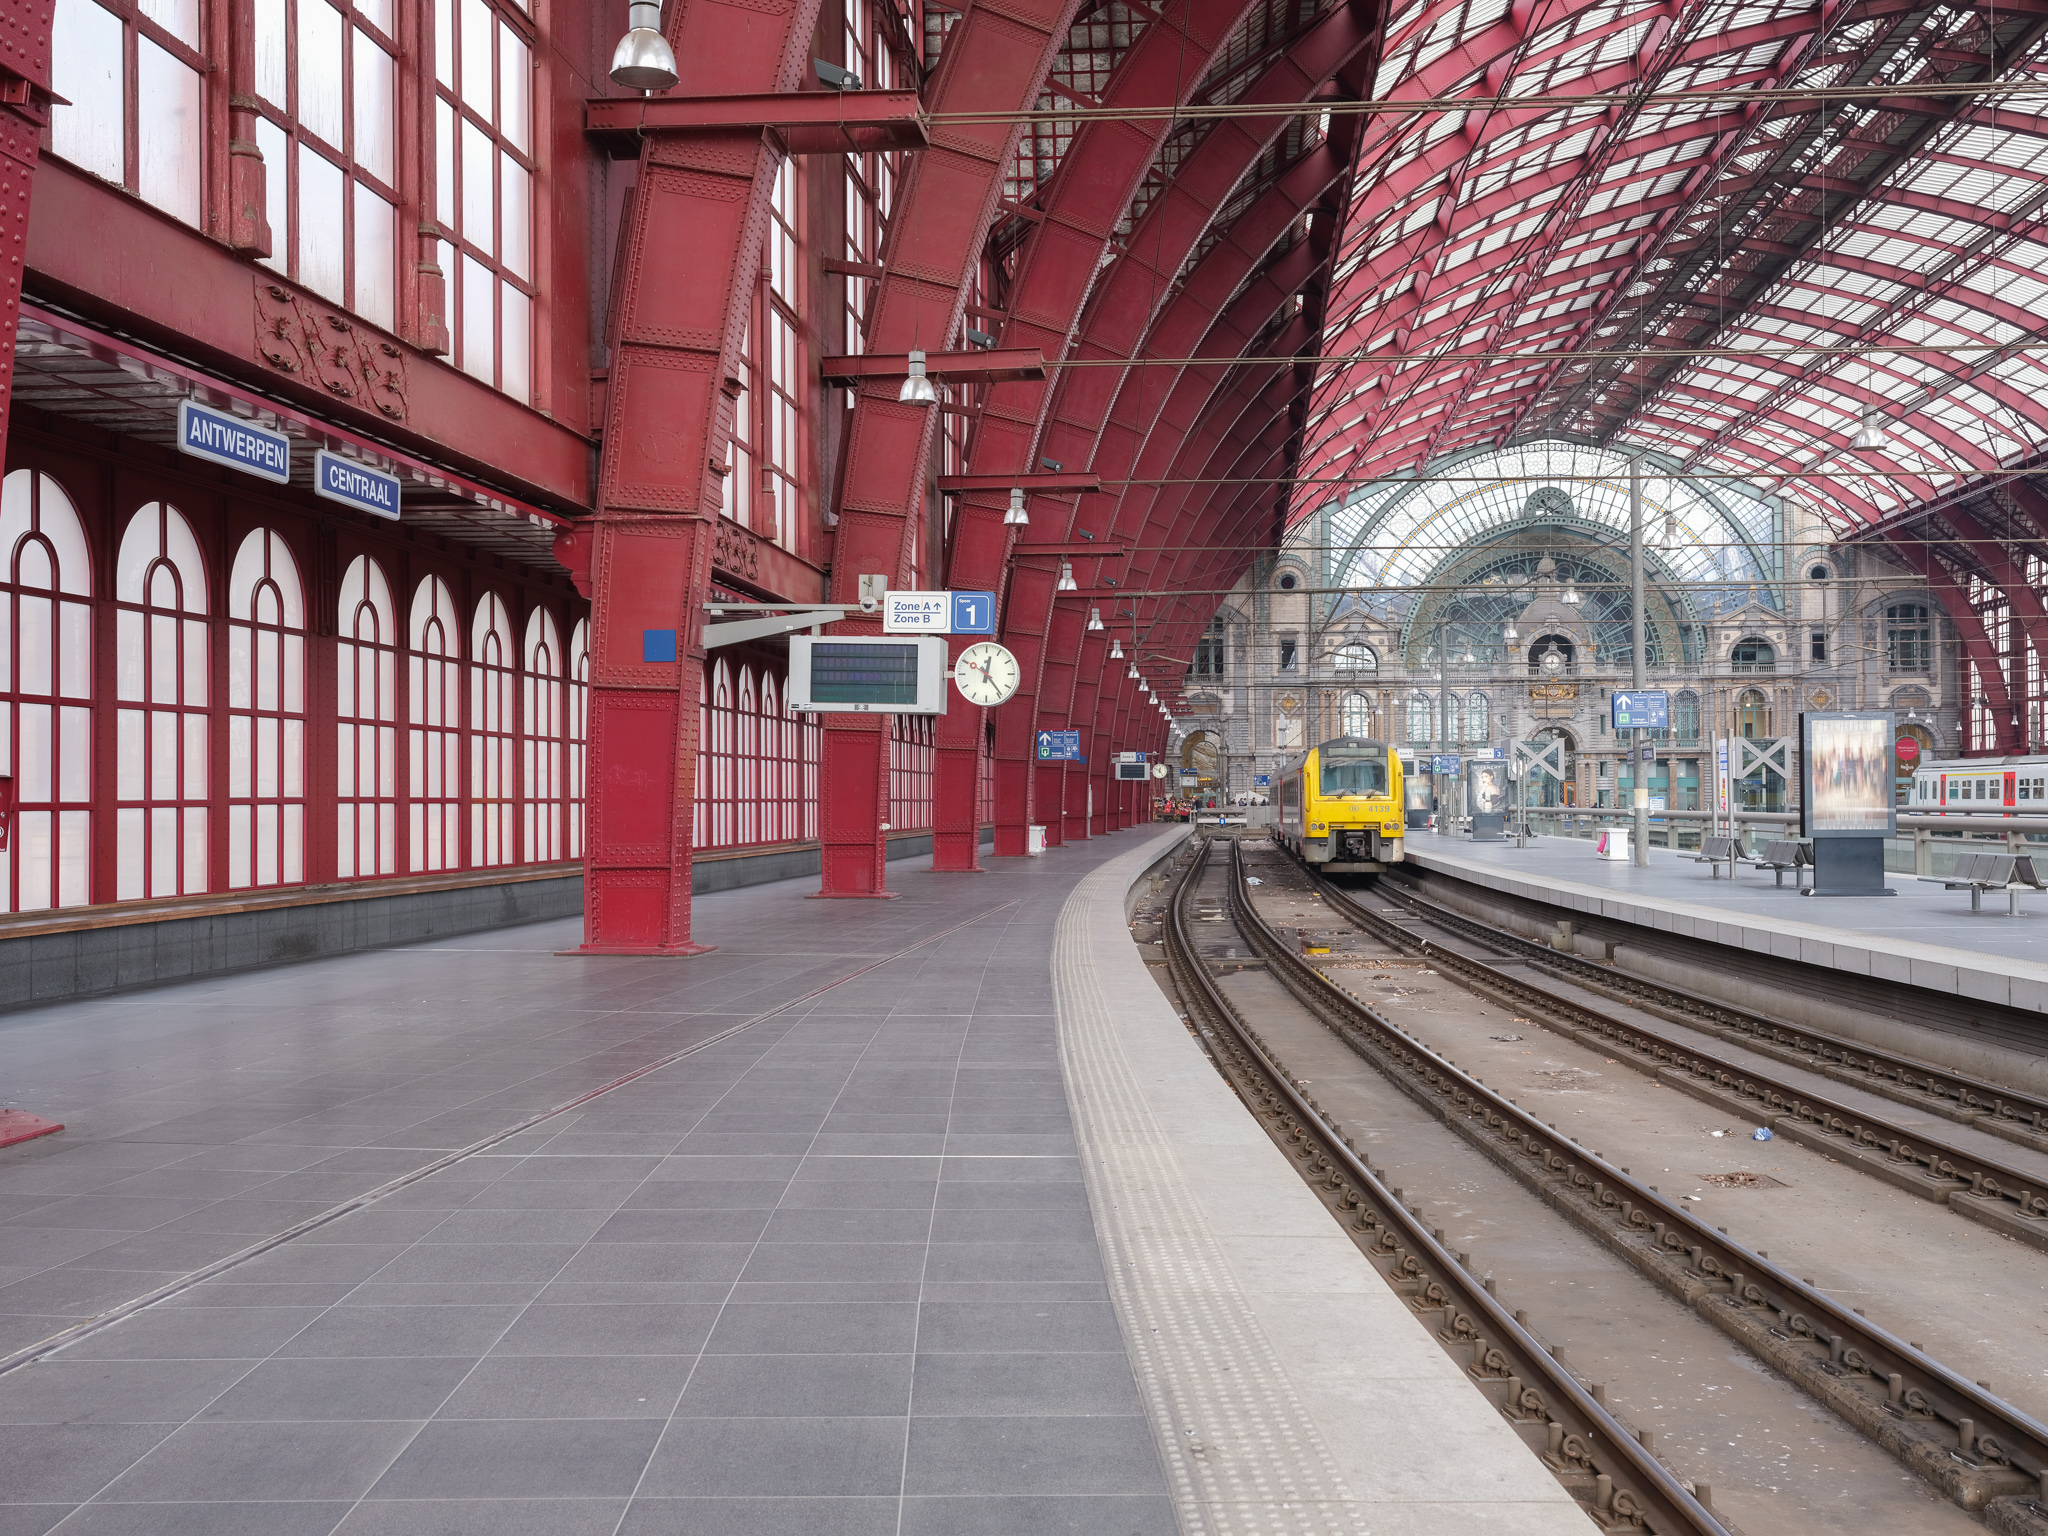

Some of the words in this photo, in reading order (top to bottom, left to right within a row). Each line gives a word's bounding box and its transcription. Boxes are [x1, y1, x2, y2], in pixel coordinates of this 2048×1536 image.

[190, 416, 284, 470] ANTWERPEN
[329, 465, 391, 507] CENTRAAL
[894, 602, 920, 611] Zone
[923, 602, 931, 610] A
[894, 614, 920, 623] Zone
[923, 614, 931, 623] B
[965, 604, 976, 626] 1
[1368, 805, 1390, 813] 4139
